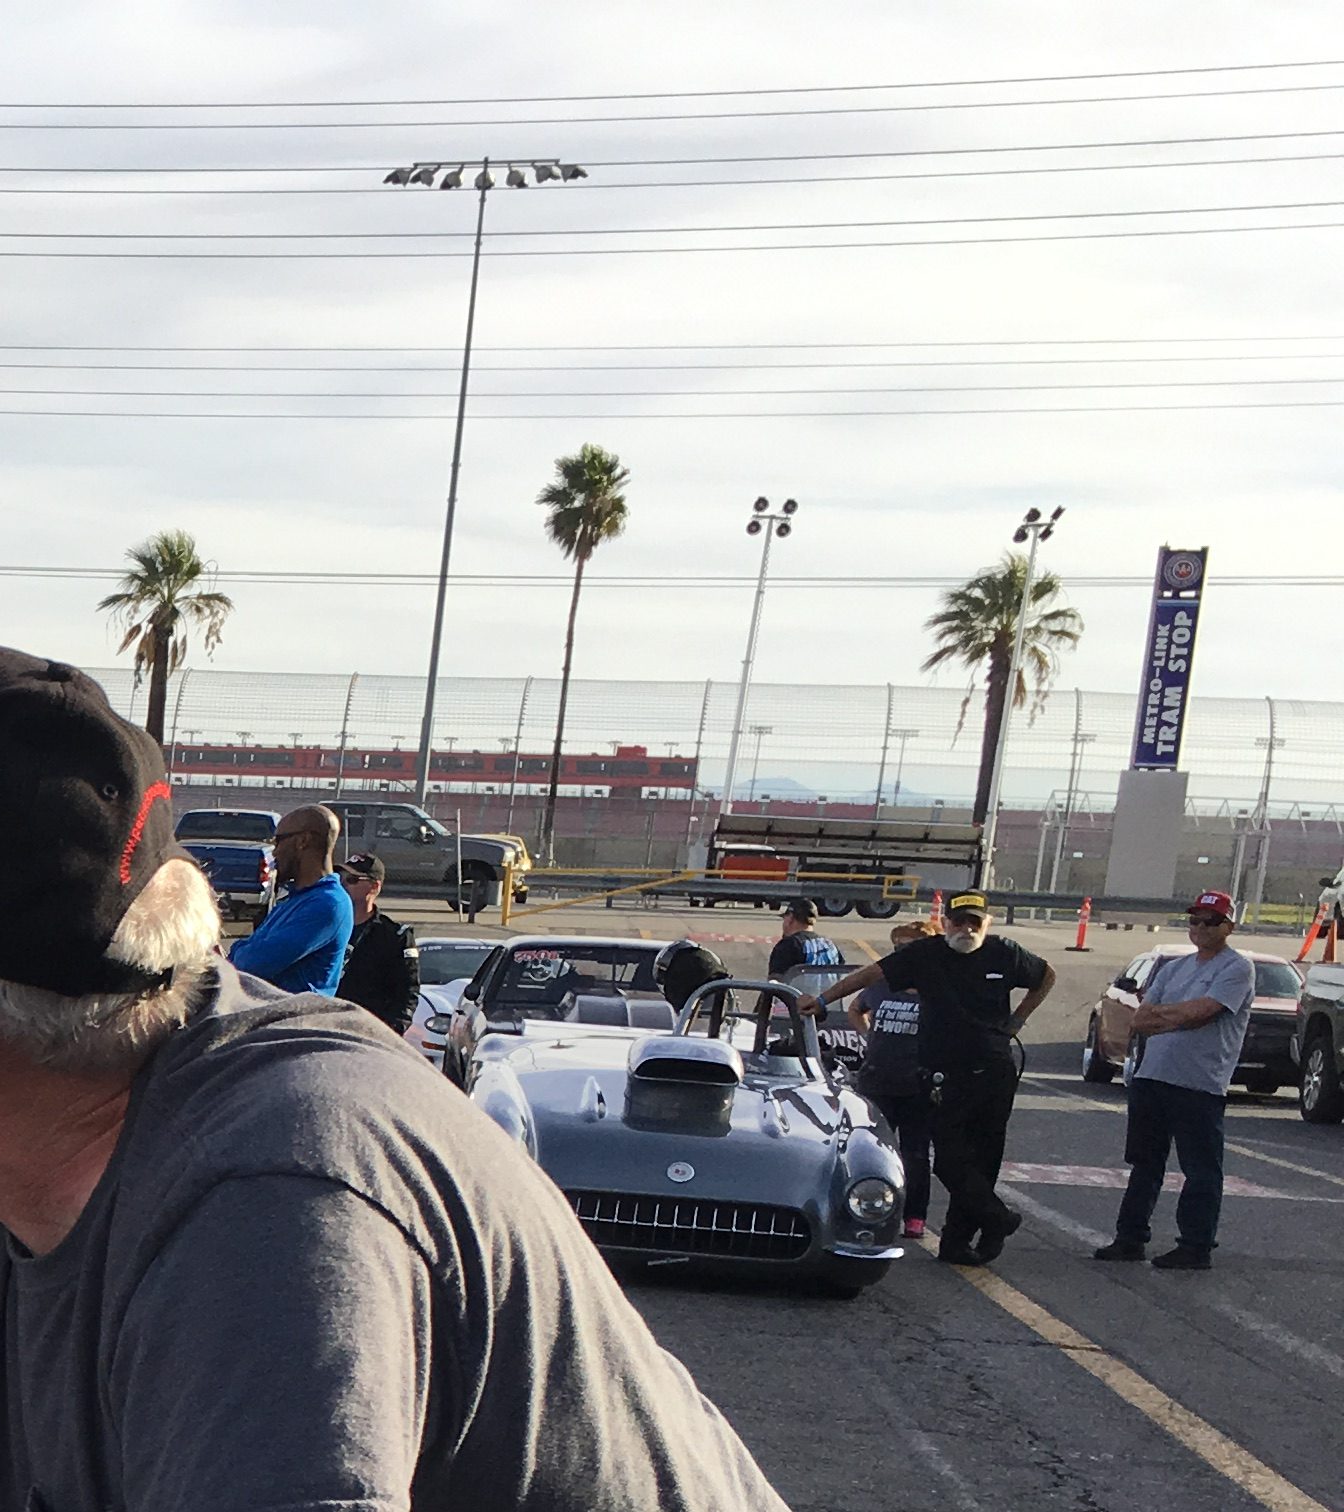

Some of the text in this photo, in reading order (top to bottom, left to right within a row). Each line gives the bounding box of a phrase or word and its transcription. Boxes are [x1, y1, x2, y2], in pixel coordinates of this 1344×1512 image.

[1167, 610, 1194, 673] STOP
[1142, 623, 1171, 744] METRO-LINK
[1156, 685, 1184, 756] TRAM
[874, 1020, 919, 1035] F-WORD
